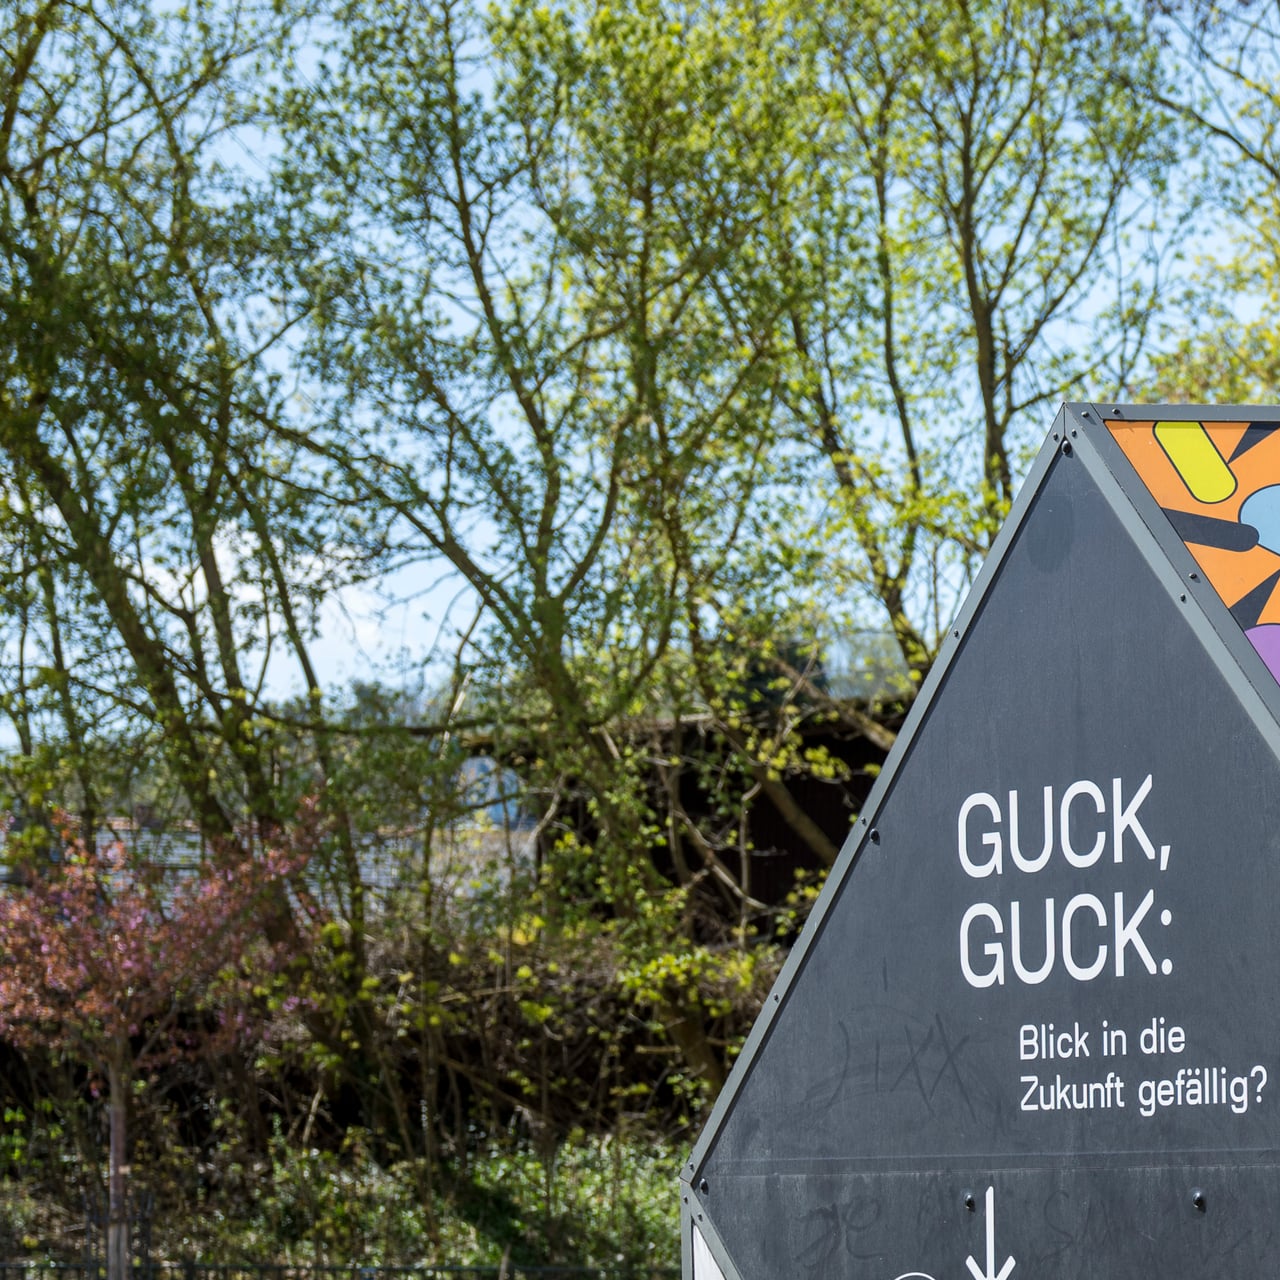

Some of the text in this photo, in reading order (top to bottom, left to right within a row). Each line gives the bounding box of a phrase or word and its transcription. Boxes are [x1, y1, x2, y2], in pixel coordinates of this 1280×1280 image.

[958, 774, 1171, 878] GUCK,
[959, 889, 1173, 988] GUCK:
[1019, 1016, 1186, 1061] Blick in die
[1020, 1065, 1268, 1117] Zukunft gefällig?
